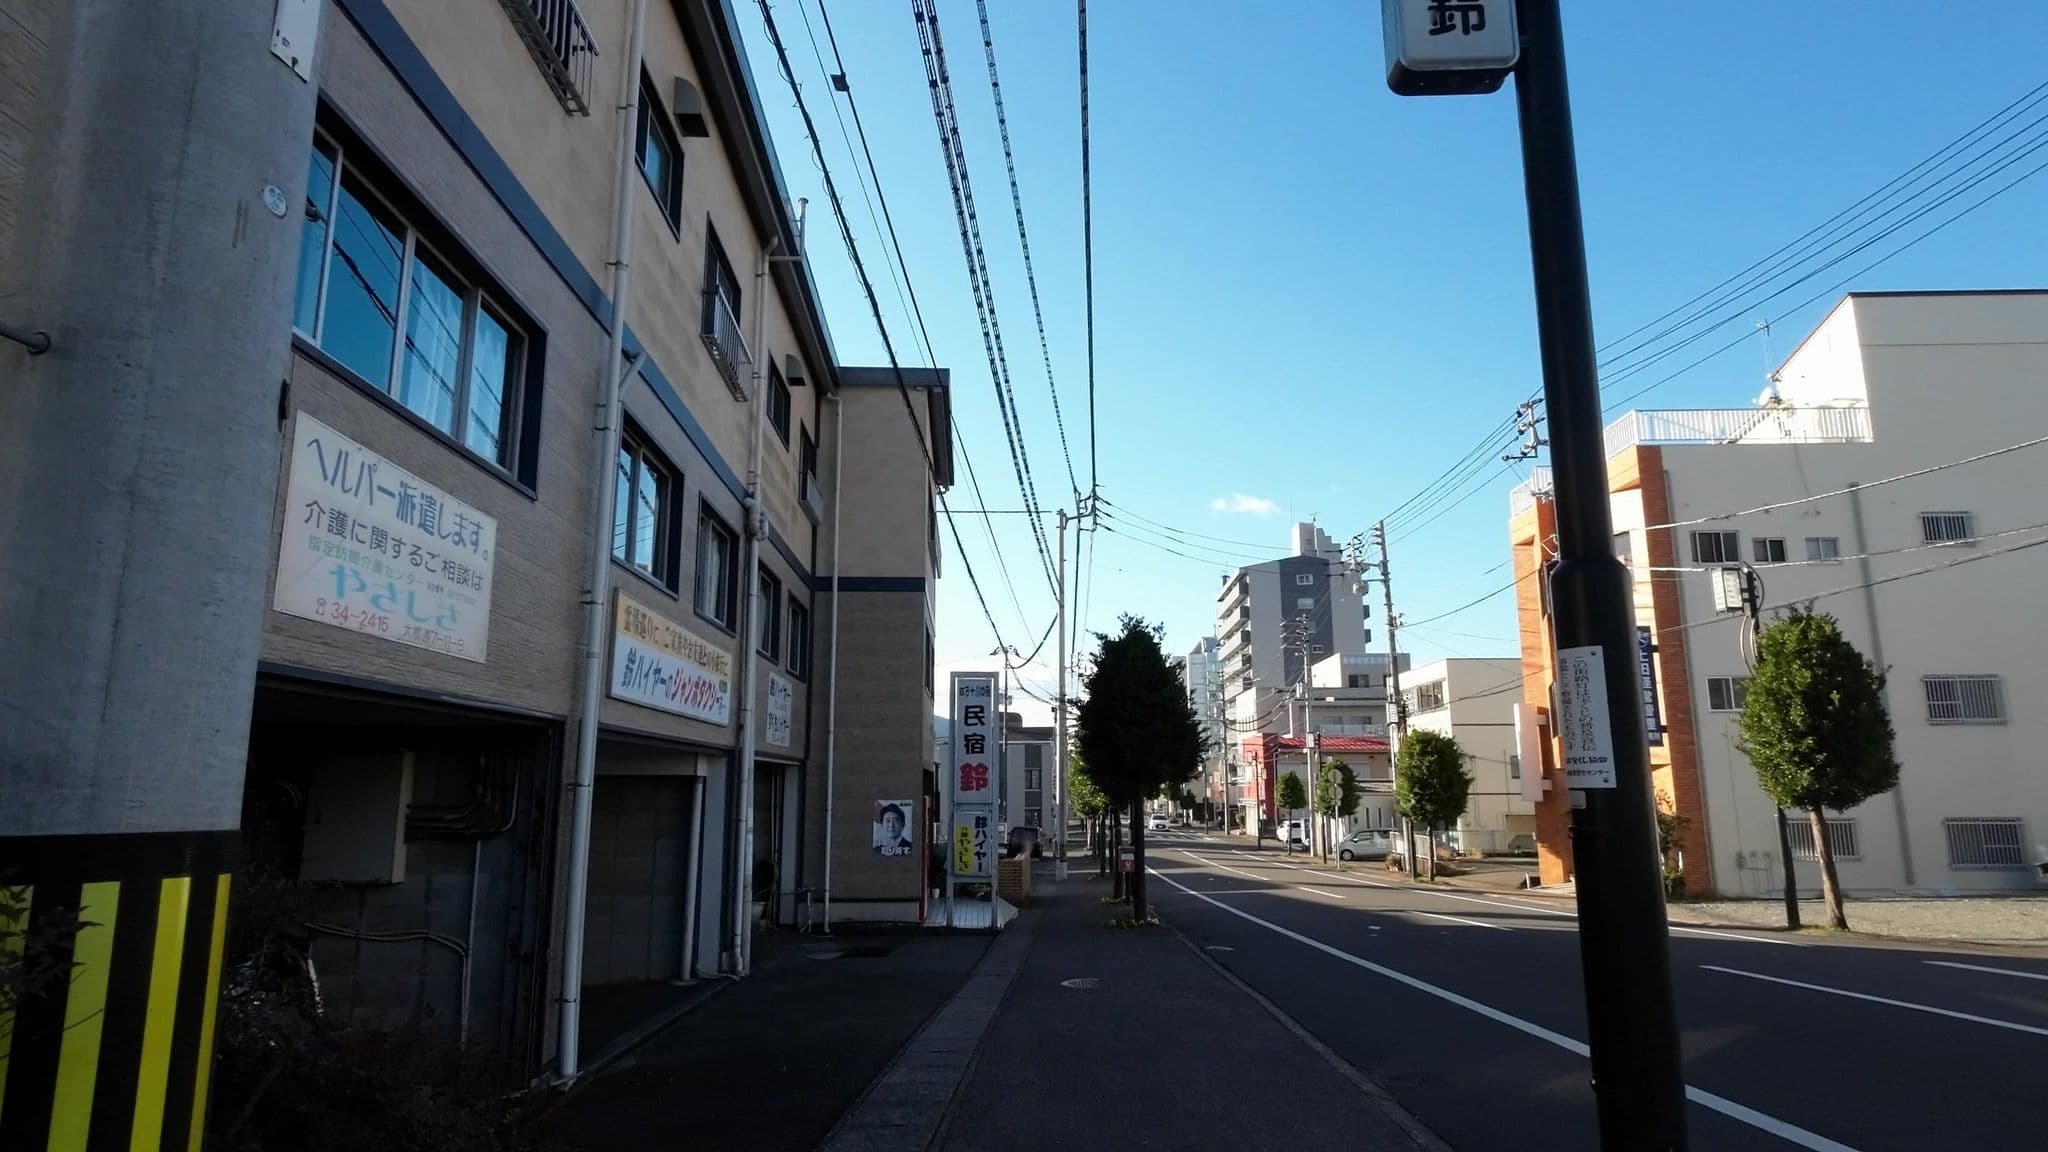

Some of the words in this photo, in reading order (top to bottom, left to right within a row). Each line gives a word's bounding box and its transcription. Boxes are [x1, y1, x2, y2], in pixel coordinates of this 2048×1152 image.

[307, 438, 488, 562] ヘルパー派遣します。
[304, 500, 484, 591] 介護に関するご相談は
[329, 564, 462, 630] やさしさ
[974, 816, 988, 873] 鈴ハイヤー
